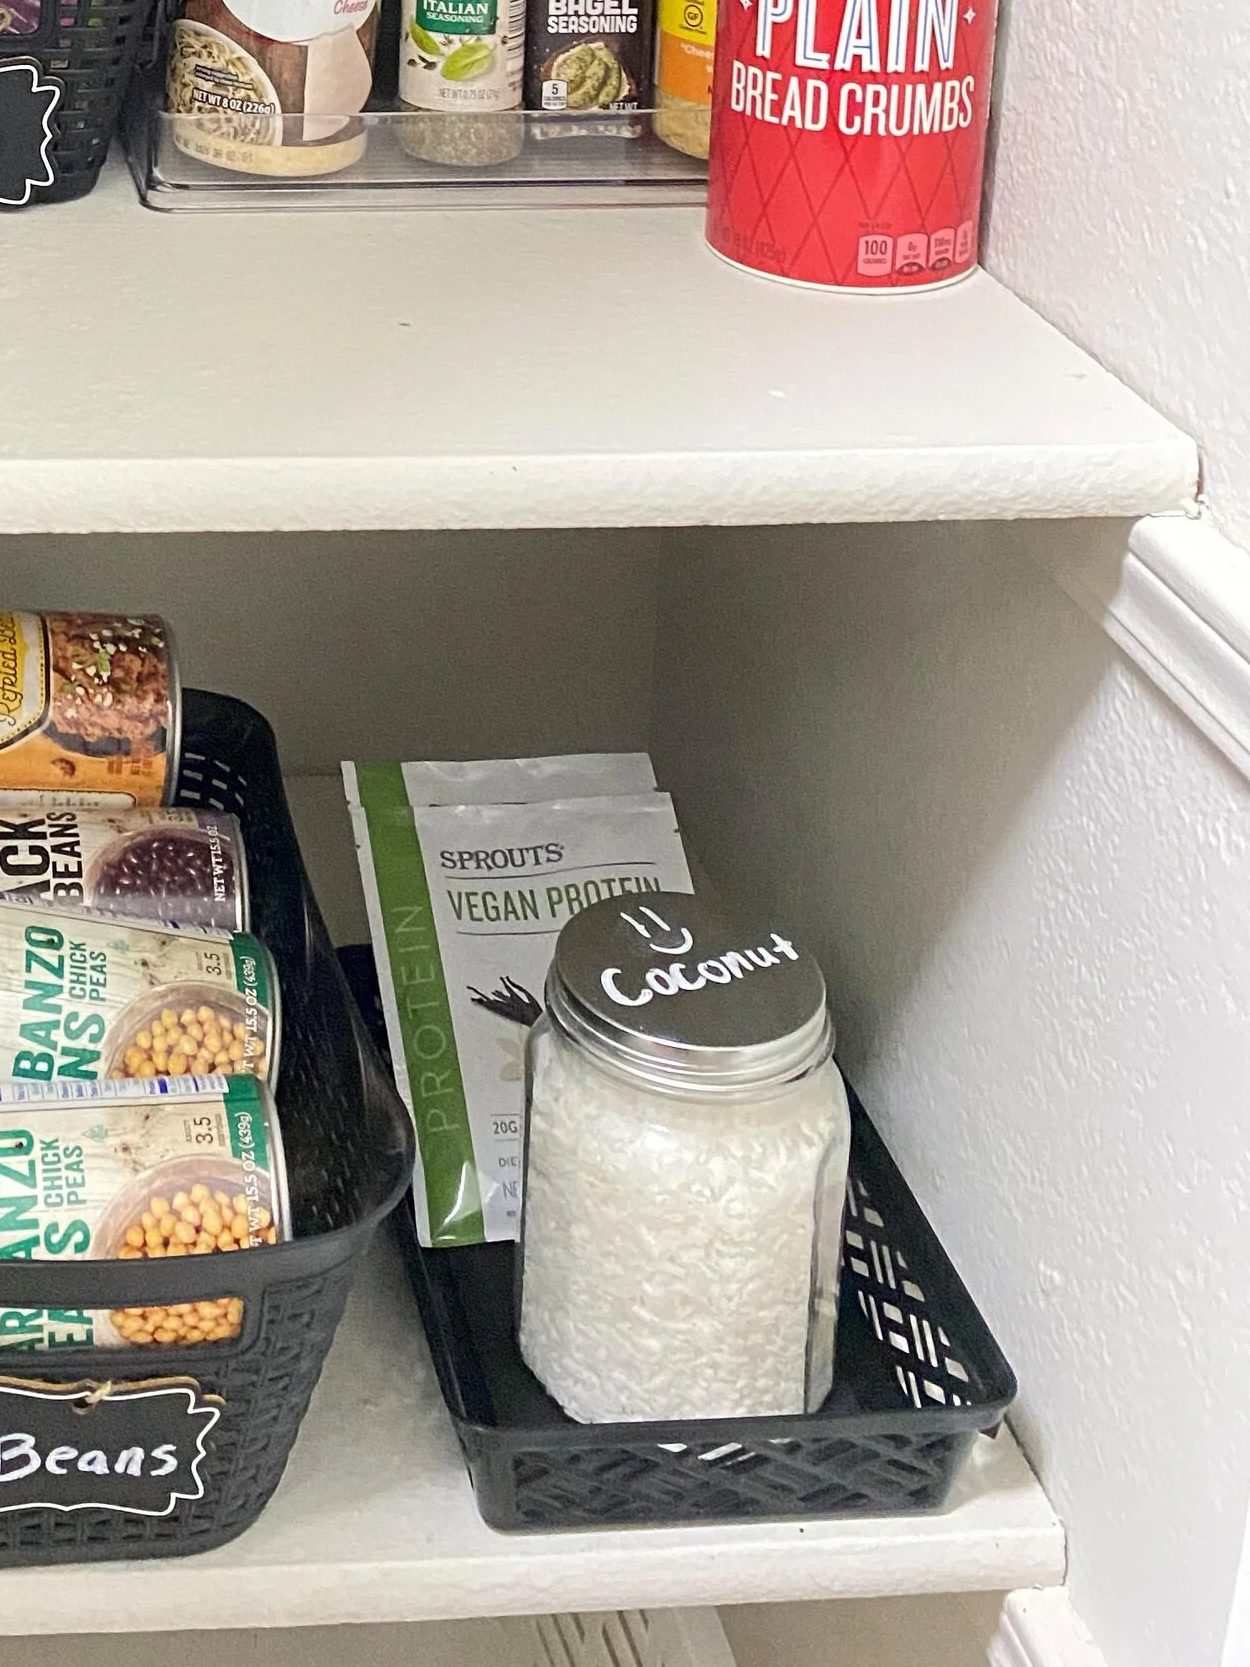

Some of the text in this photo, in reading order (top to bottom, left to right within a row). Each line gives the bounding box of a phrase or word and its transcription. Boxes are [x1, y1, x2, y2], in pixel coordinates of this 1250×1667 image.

[333, 0, 368, 15] Cheese
[427, 13, 484, 24] SEASONING
[687, 11, 699, 21] GF
[547, 15, 638, 34] SEASONING
[193, 89, 276, 115] NET WT 8 OZ (226g)
[551, 84, 559, 95] 5
[730, 59, 975, 137] BREAD CRUMBS
[864, 240, 888, 256] 100
[206, 825, 218, 836] OZ
[46, 812, 84, 903] BEANS
[211, 855, 224, 876] WT
[440, 843, 565, 872] SPROUTS
[213, 877, 226, 902] NET
[447, 886, 540, 922] VEGAN
[68, 940, 87, 1000] CHICK
[89, 951, 108, 1001] PEAS
[204, 952, 222, 976] 3.5
[239, 955, 258, 987] (439g)
[600, 932, 799, 1007] Coconut
[12, 925, 65, 1082] BANZO
[244, 987, 258, 1005] OZ
[245, 1008, 258, 1033] 15.5
[391, 904, 460, 1134] PROTEIN
[243, 1036, 257, 1057] WT
[193, 1116, 214, 1145] 3.5
[234, 1111, 256, 1149] (439g)
[493, 1120, 518, 1135] 20G
[39, 1138, 64, 1208] CHICK
[242, 1150, 256, 1172] OZ
[64, 1143, 88, 1206] PEAS
[244, 1174, 260, 1202] 15.5
[247, 1205, 262, 1232] WT
